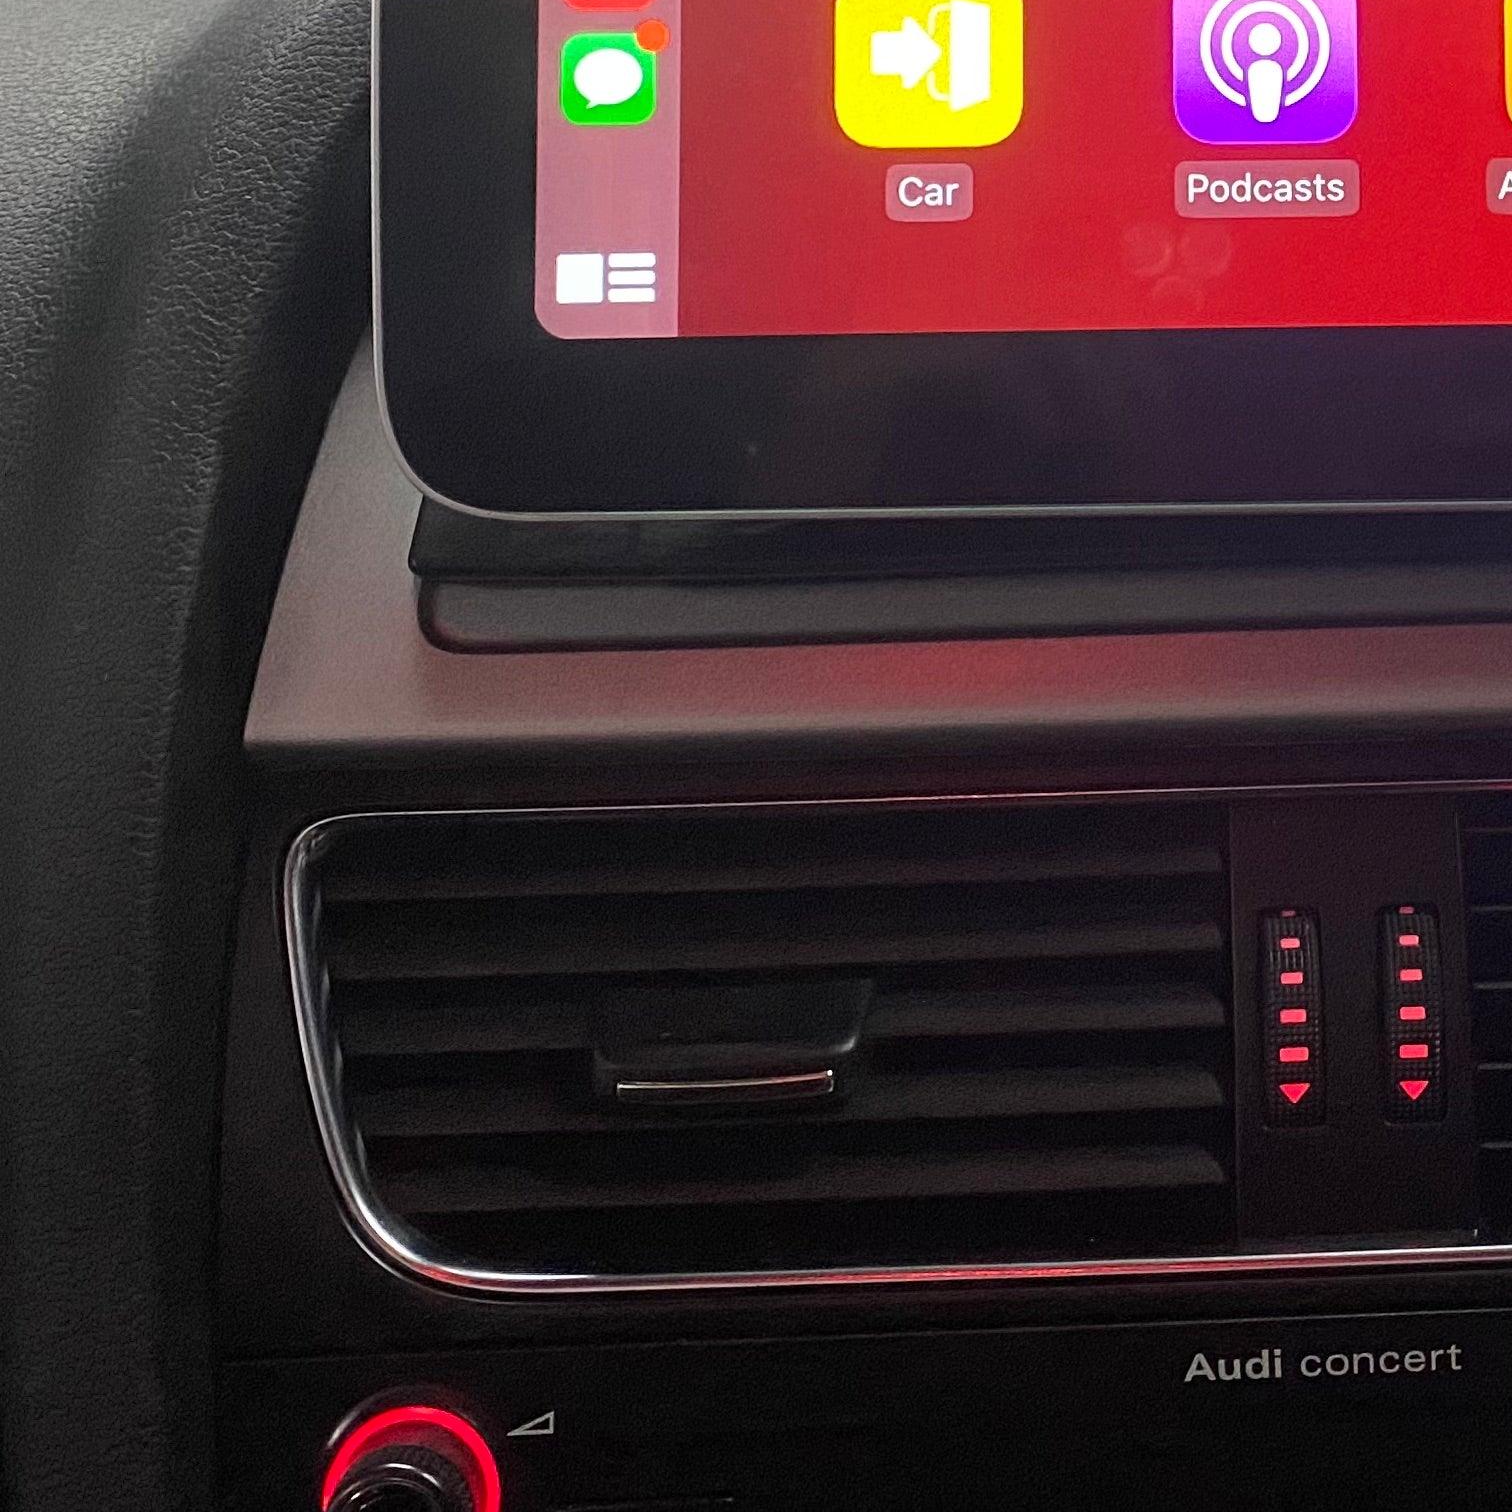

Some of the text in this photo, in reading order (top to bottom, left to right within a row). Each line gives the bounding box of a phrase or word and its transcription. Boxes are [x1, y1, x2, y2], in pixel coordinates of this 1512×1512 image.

[899, 177, 959, 206] Car
[1189, 173, 1344, 202] Podcasts
[1185, 1345, 1461, 1381] Audi concert
